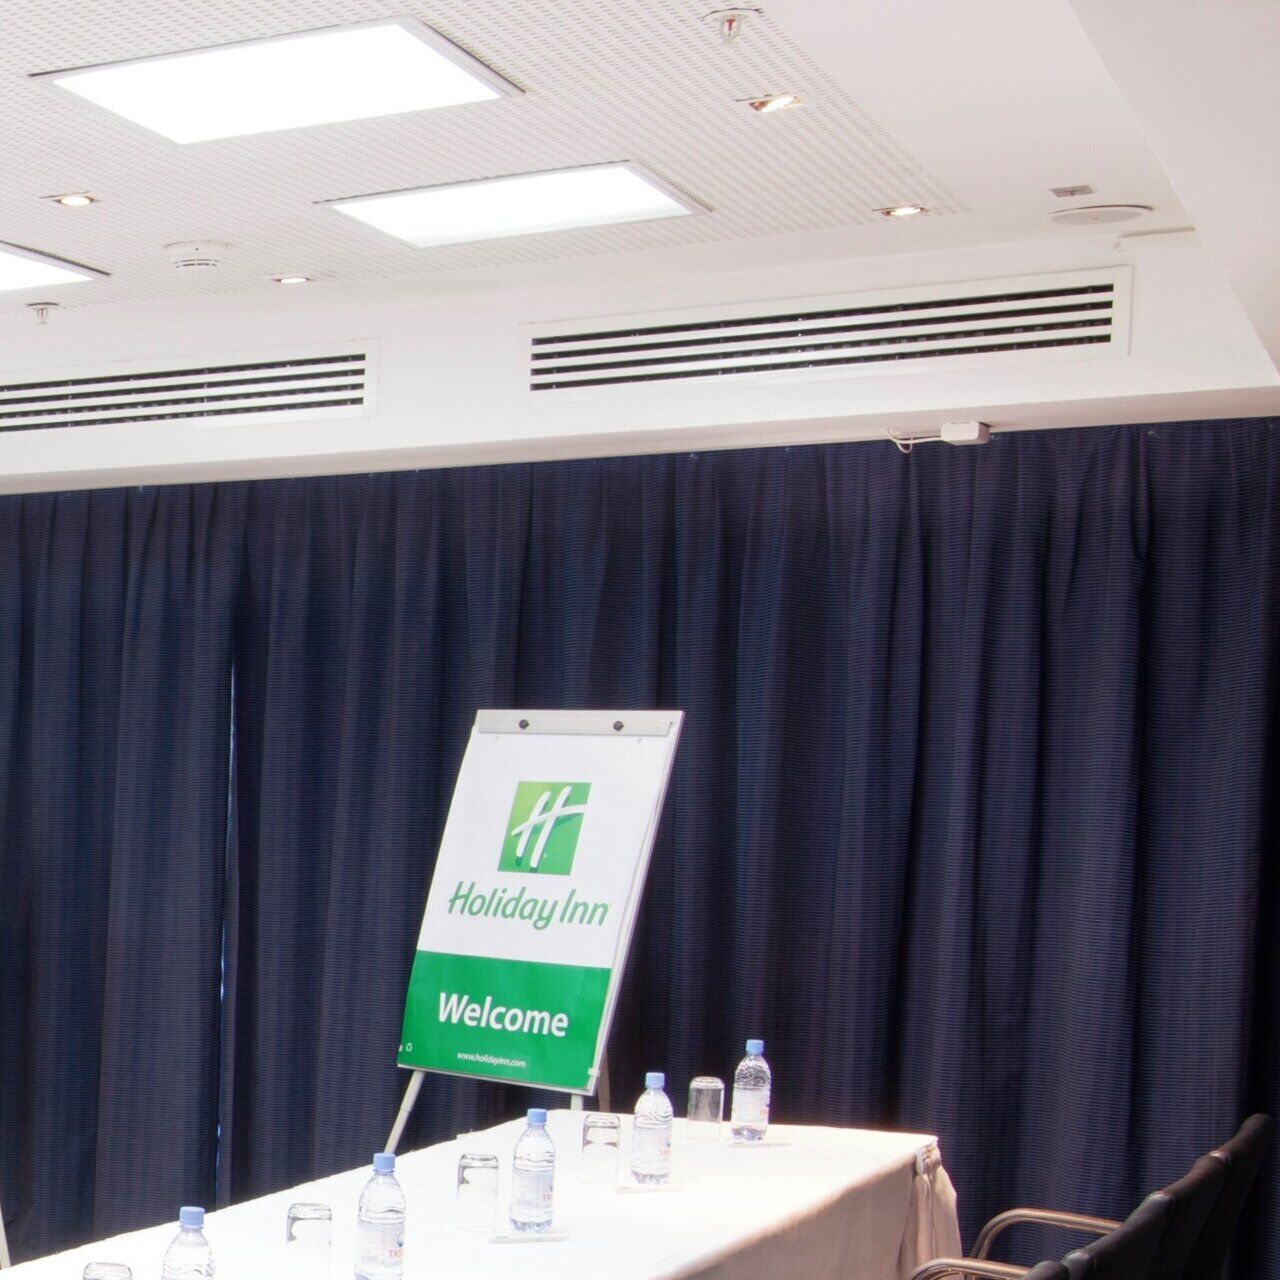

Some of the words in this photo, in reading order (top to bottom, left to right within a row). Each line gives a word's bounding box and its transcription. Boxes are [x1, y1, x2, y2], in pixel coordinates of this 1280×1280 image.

[448, 881, 559, 931] Holiday
[559, 889, 610, 926] Inn
[439, 992, 569, 1037] Welcome
[457, 1052, 527, 1068] www.holidayinn.com
